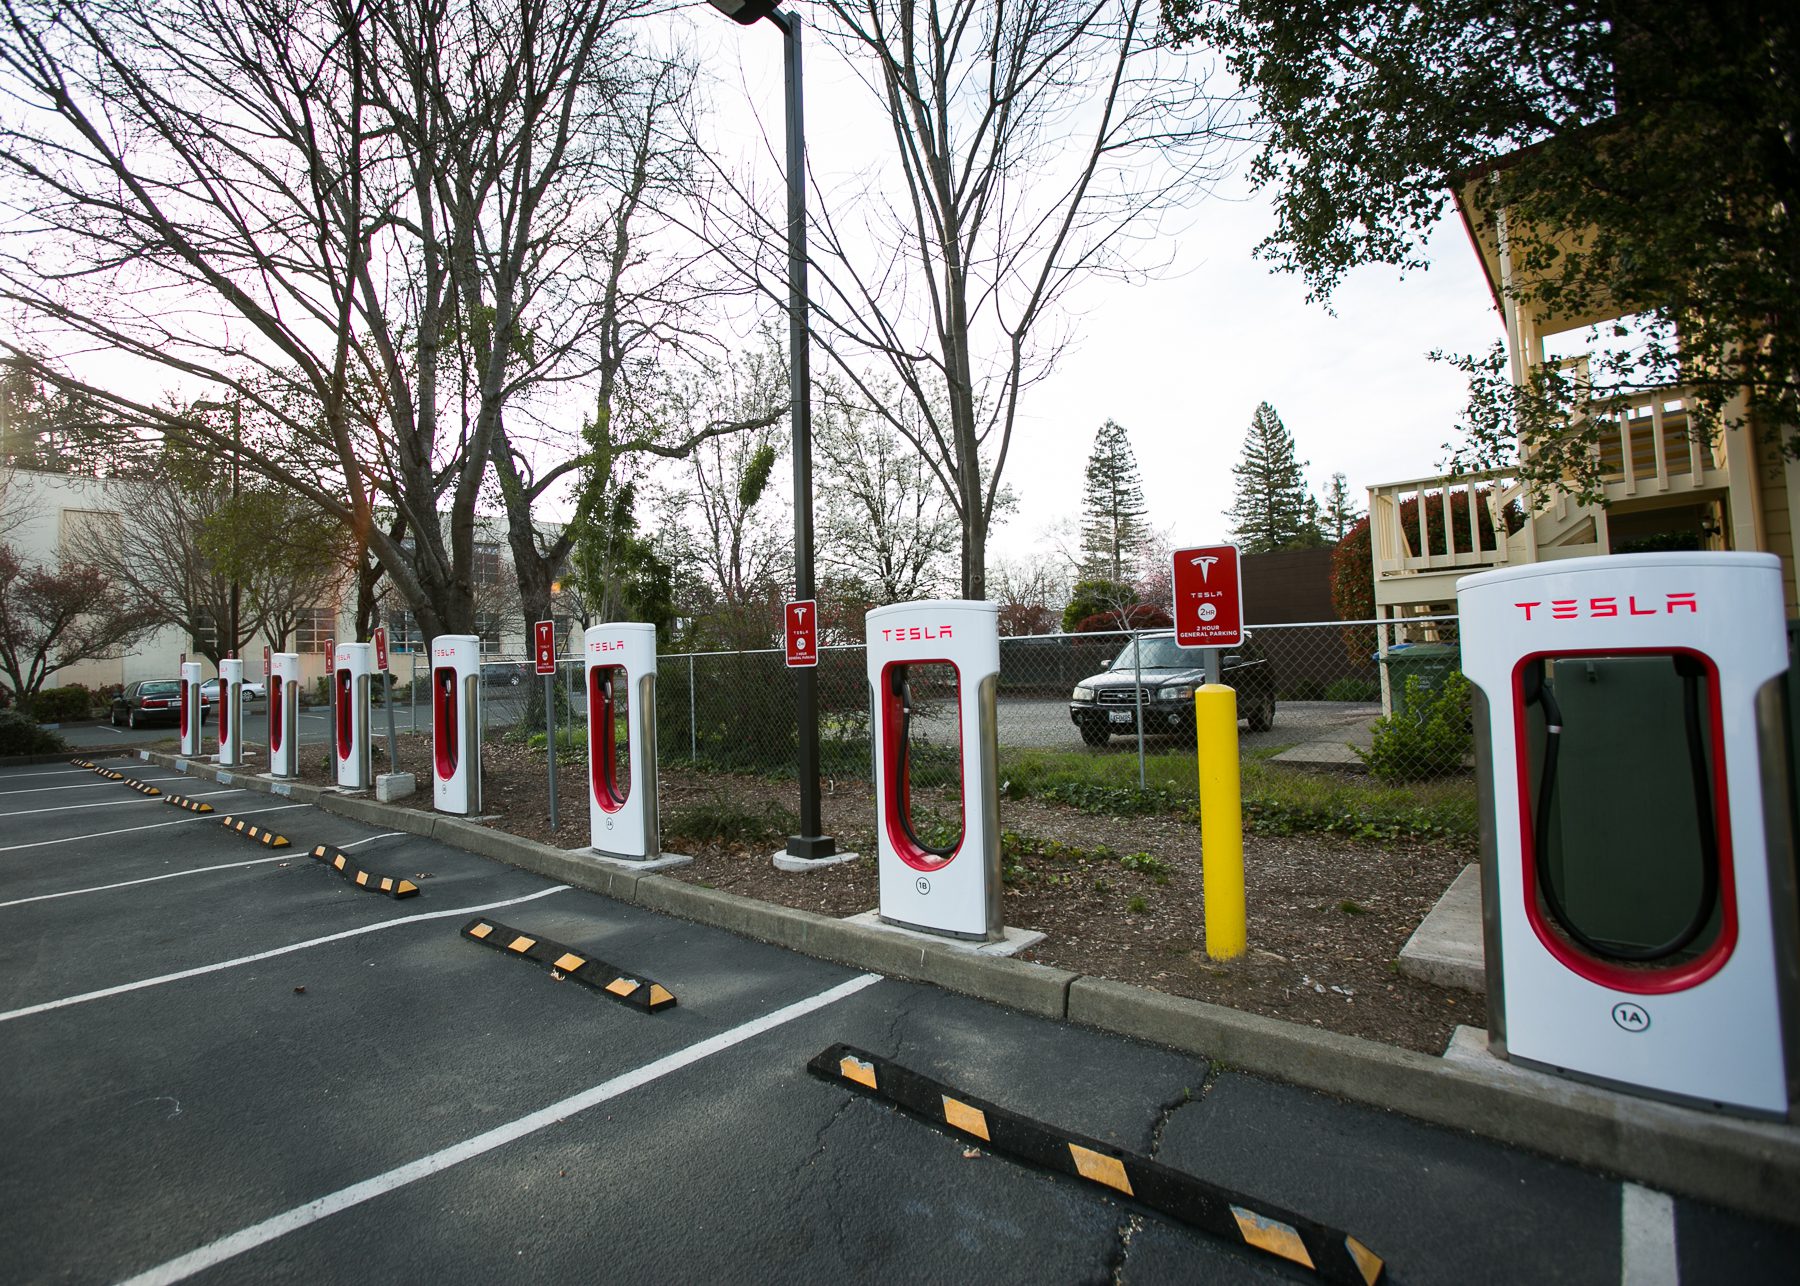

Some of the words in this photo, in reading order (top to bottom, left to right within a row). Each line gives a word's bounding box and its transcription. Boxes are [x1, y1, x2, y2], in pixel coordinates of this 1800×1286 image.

[1514, 592, 1697, 621] TESLA
[882, 625, 952, 641] TESLA
[590, 640, 624, 651] TESLA
[1619, 1010, 1643, 1025] 1A
